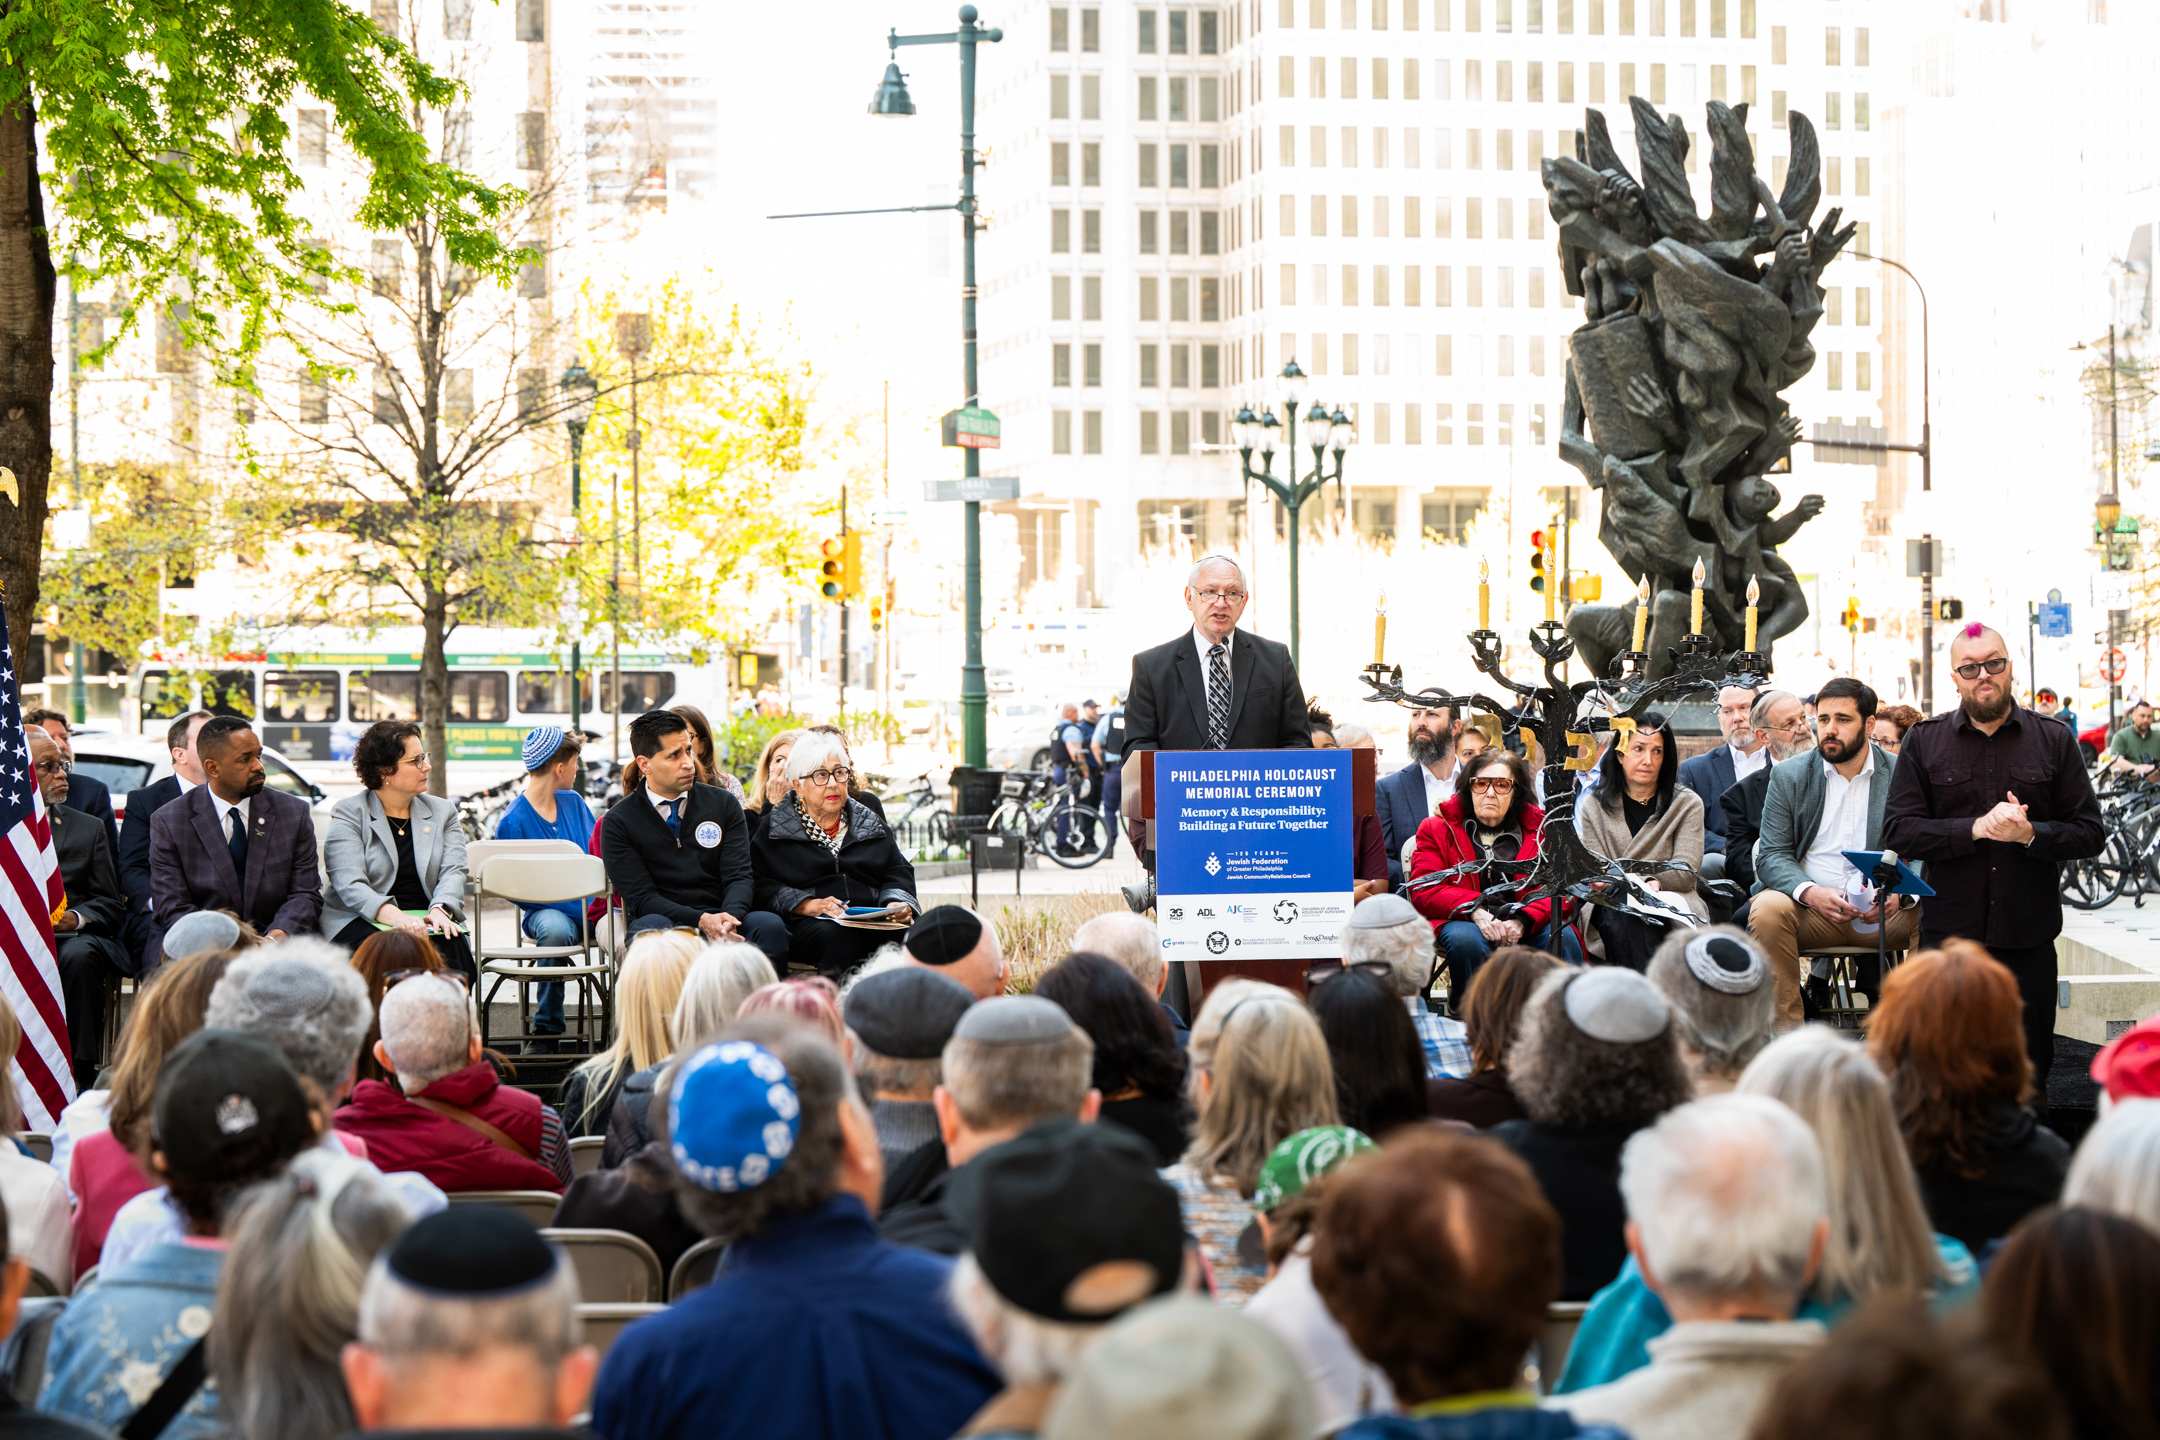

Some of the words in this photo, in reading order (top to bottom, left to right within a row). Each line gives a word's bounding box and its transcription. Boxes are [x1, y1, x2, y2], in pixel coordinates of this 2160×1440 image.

[1171, 770, 1261, 782] PHILADELPHIA
[1264, 768, 1337, 781] HOLOCAUST
[1185, 787, 1251, 799] MEMORIAL
[1255, 786, 1322, 798] CEREMONY
[1181, 807, 1228, 819] Memory
[1230, 807, 1239, 817] &
[1241, 806, 1326, 819] Responsibility:
[1179, 821, 1228, 832] Building
[1238, 820, 1276, 830] Future
[1277, 820, 1328, 831] Together
[1226, 858, 1250, 866] Jewish
[1197, 908, 1216, 917] ADL
[1227, 904, 1243, 914] AJC
